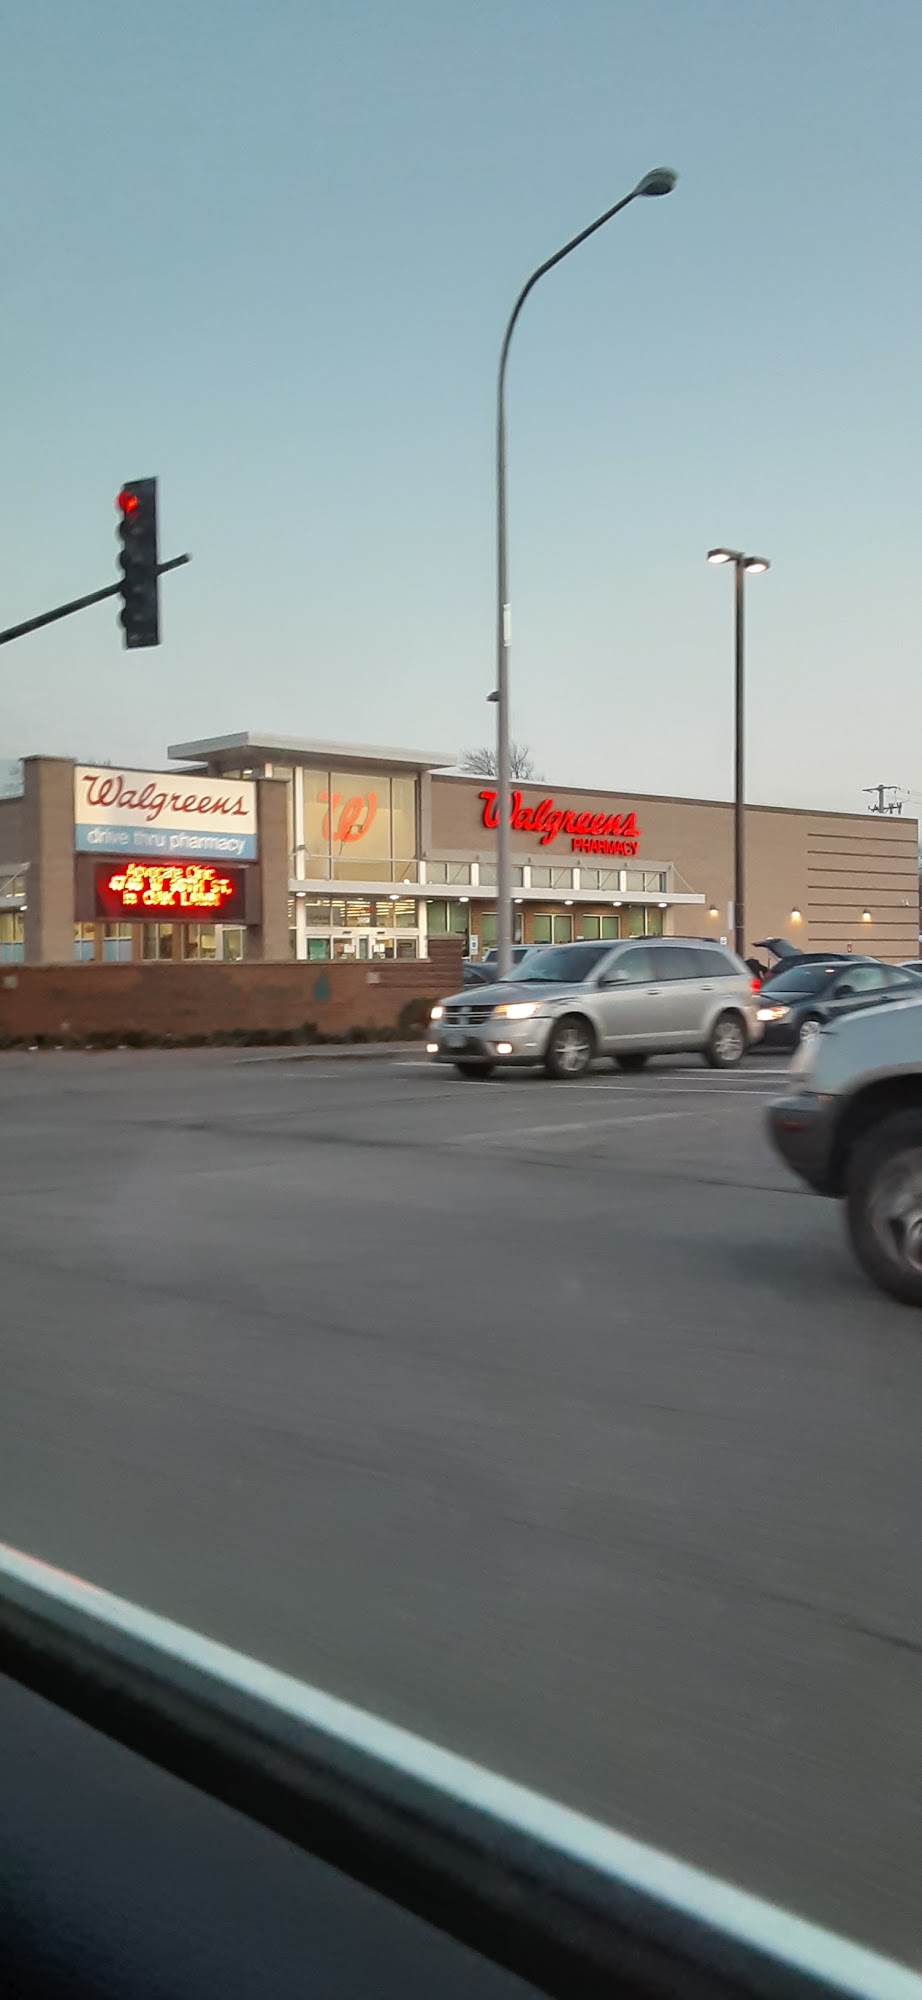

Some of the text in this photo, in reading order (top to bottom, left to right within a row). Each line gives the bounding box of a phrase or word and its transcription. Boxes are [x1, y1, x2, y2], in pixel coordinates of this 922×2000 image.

[83, 775, 250, 821] Walgreens
[480, 790, 641, 845] Walgreens
[87, 827, 247, 855] drive thru pharmacy
[572, 838, 640, 857] PHARMACY
